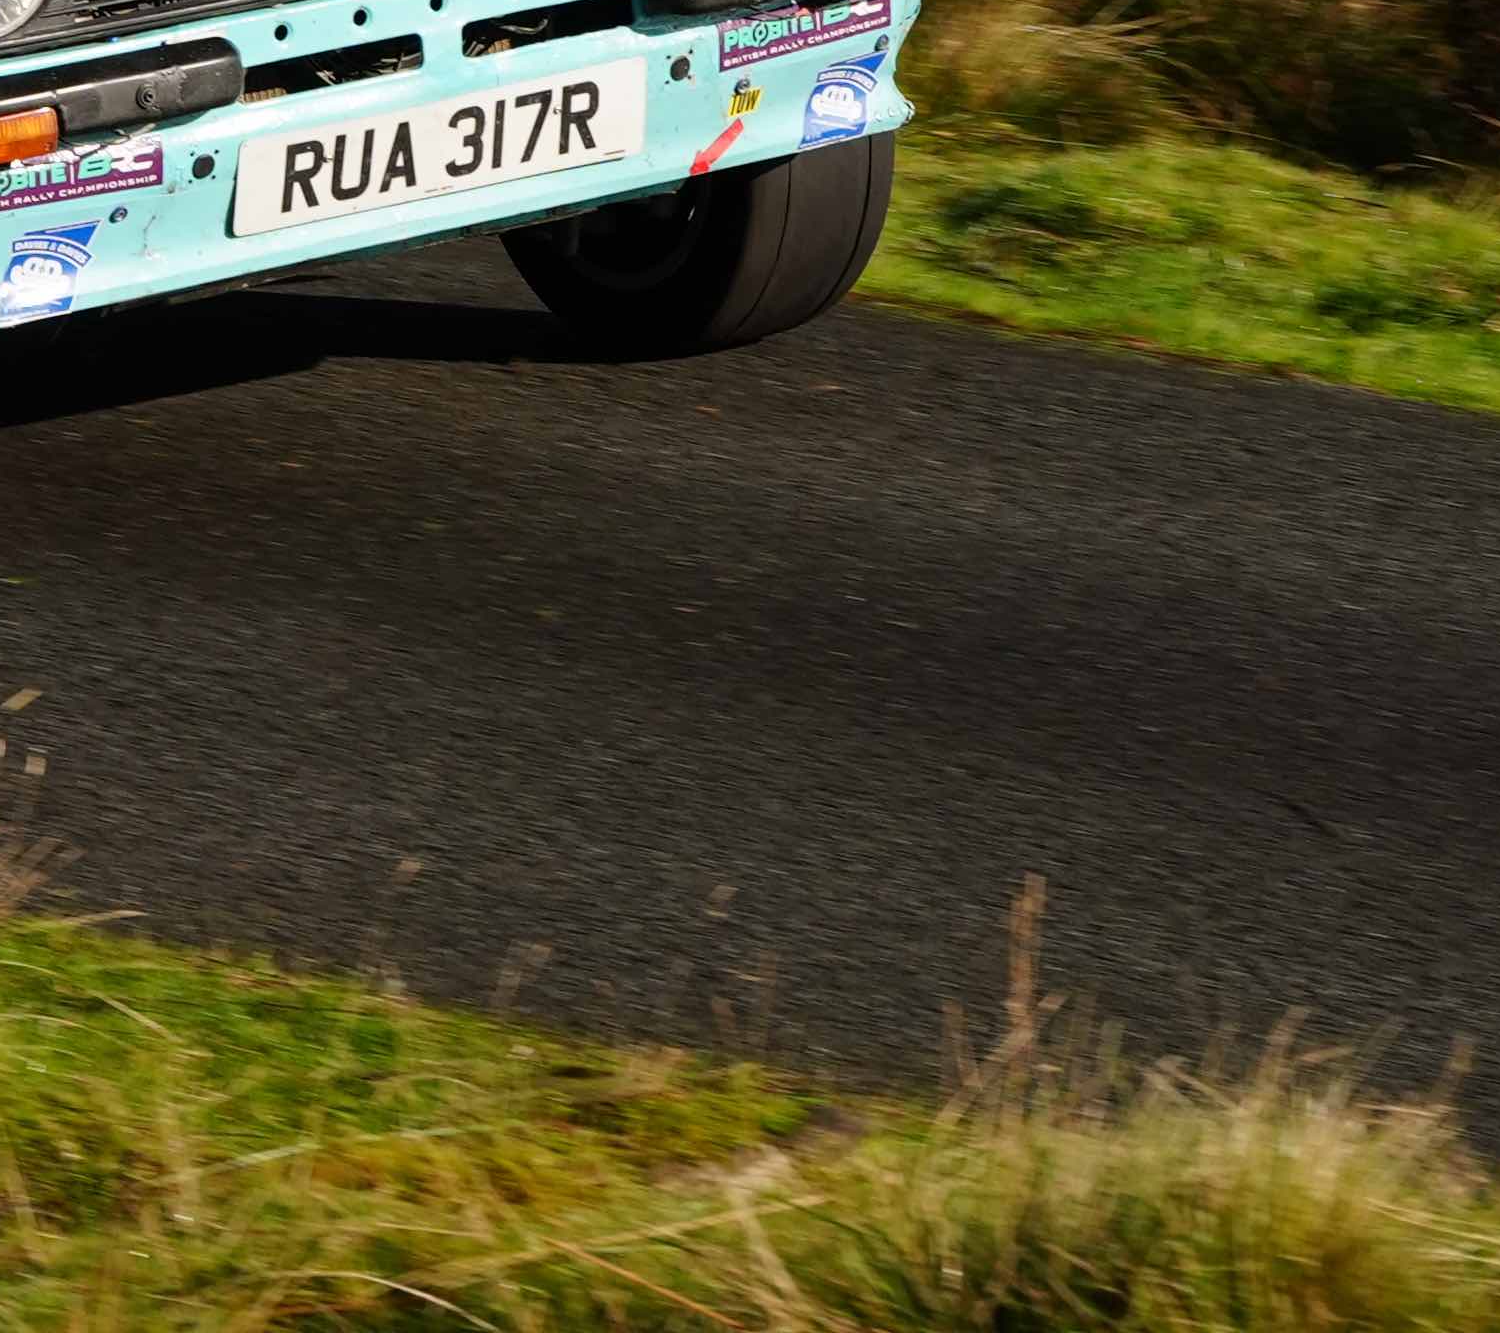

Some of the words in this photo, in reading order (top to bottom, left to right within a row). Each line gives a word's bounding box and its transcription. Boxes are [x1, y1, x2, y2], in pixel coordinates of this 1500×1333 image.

[722, 50, 767, 67] BRITISH
[769, 39, 805, 55] RALLY
[808, 16, 888, 45] CHAMPIONSHIP
[731, 90, 760, 116] TOW
[280, 121, 417, 214] RUA
[445, 81, 601, 178] 317R
[13, 190, 55, 205] RALLY
[58, 174, 158, 198] CHAMPIONSHIP
